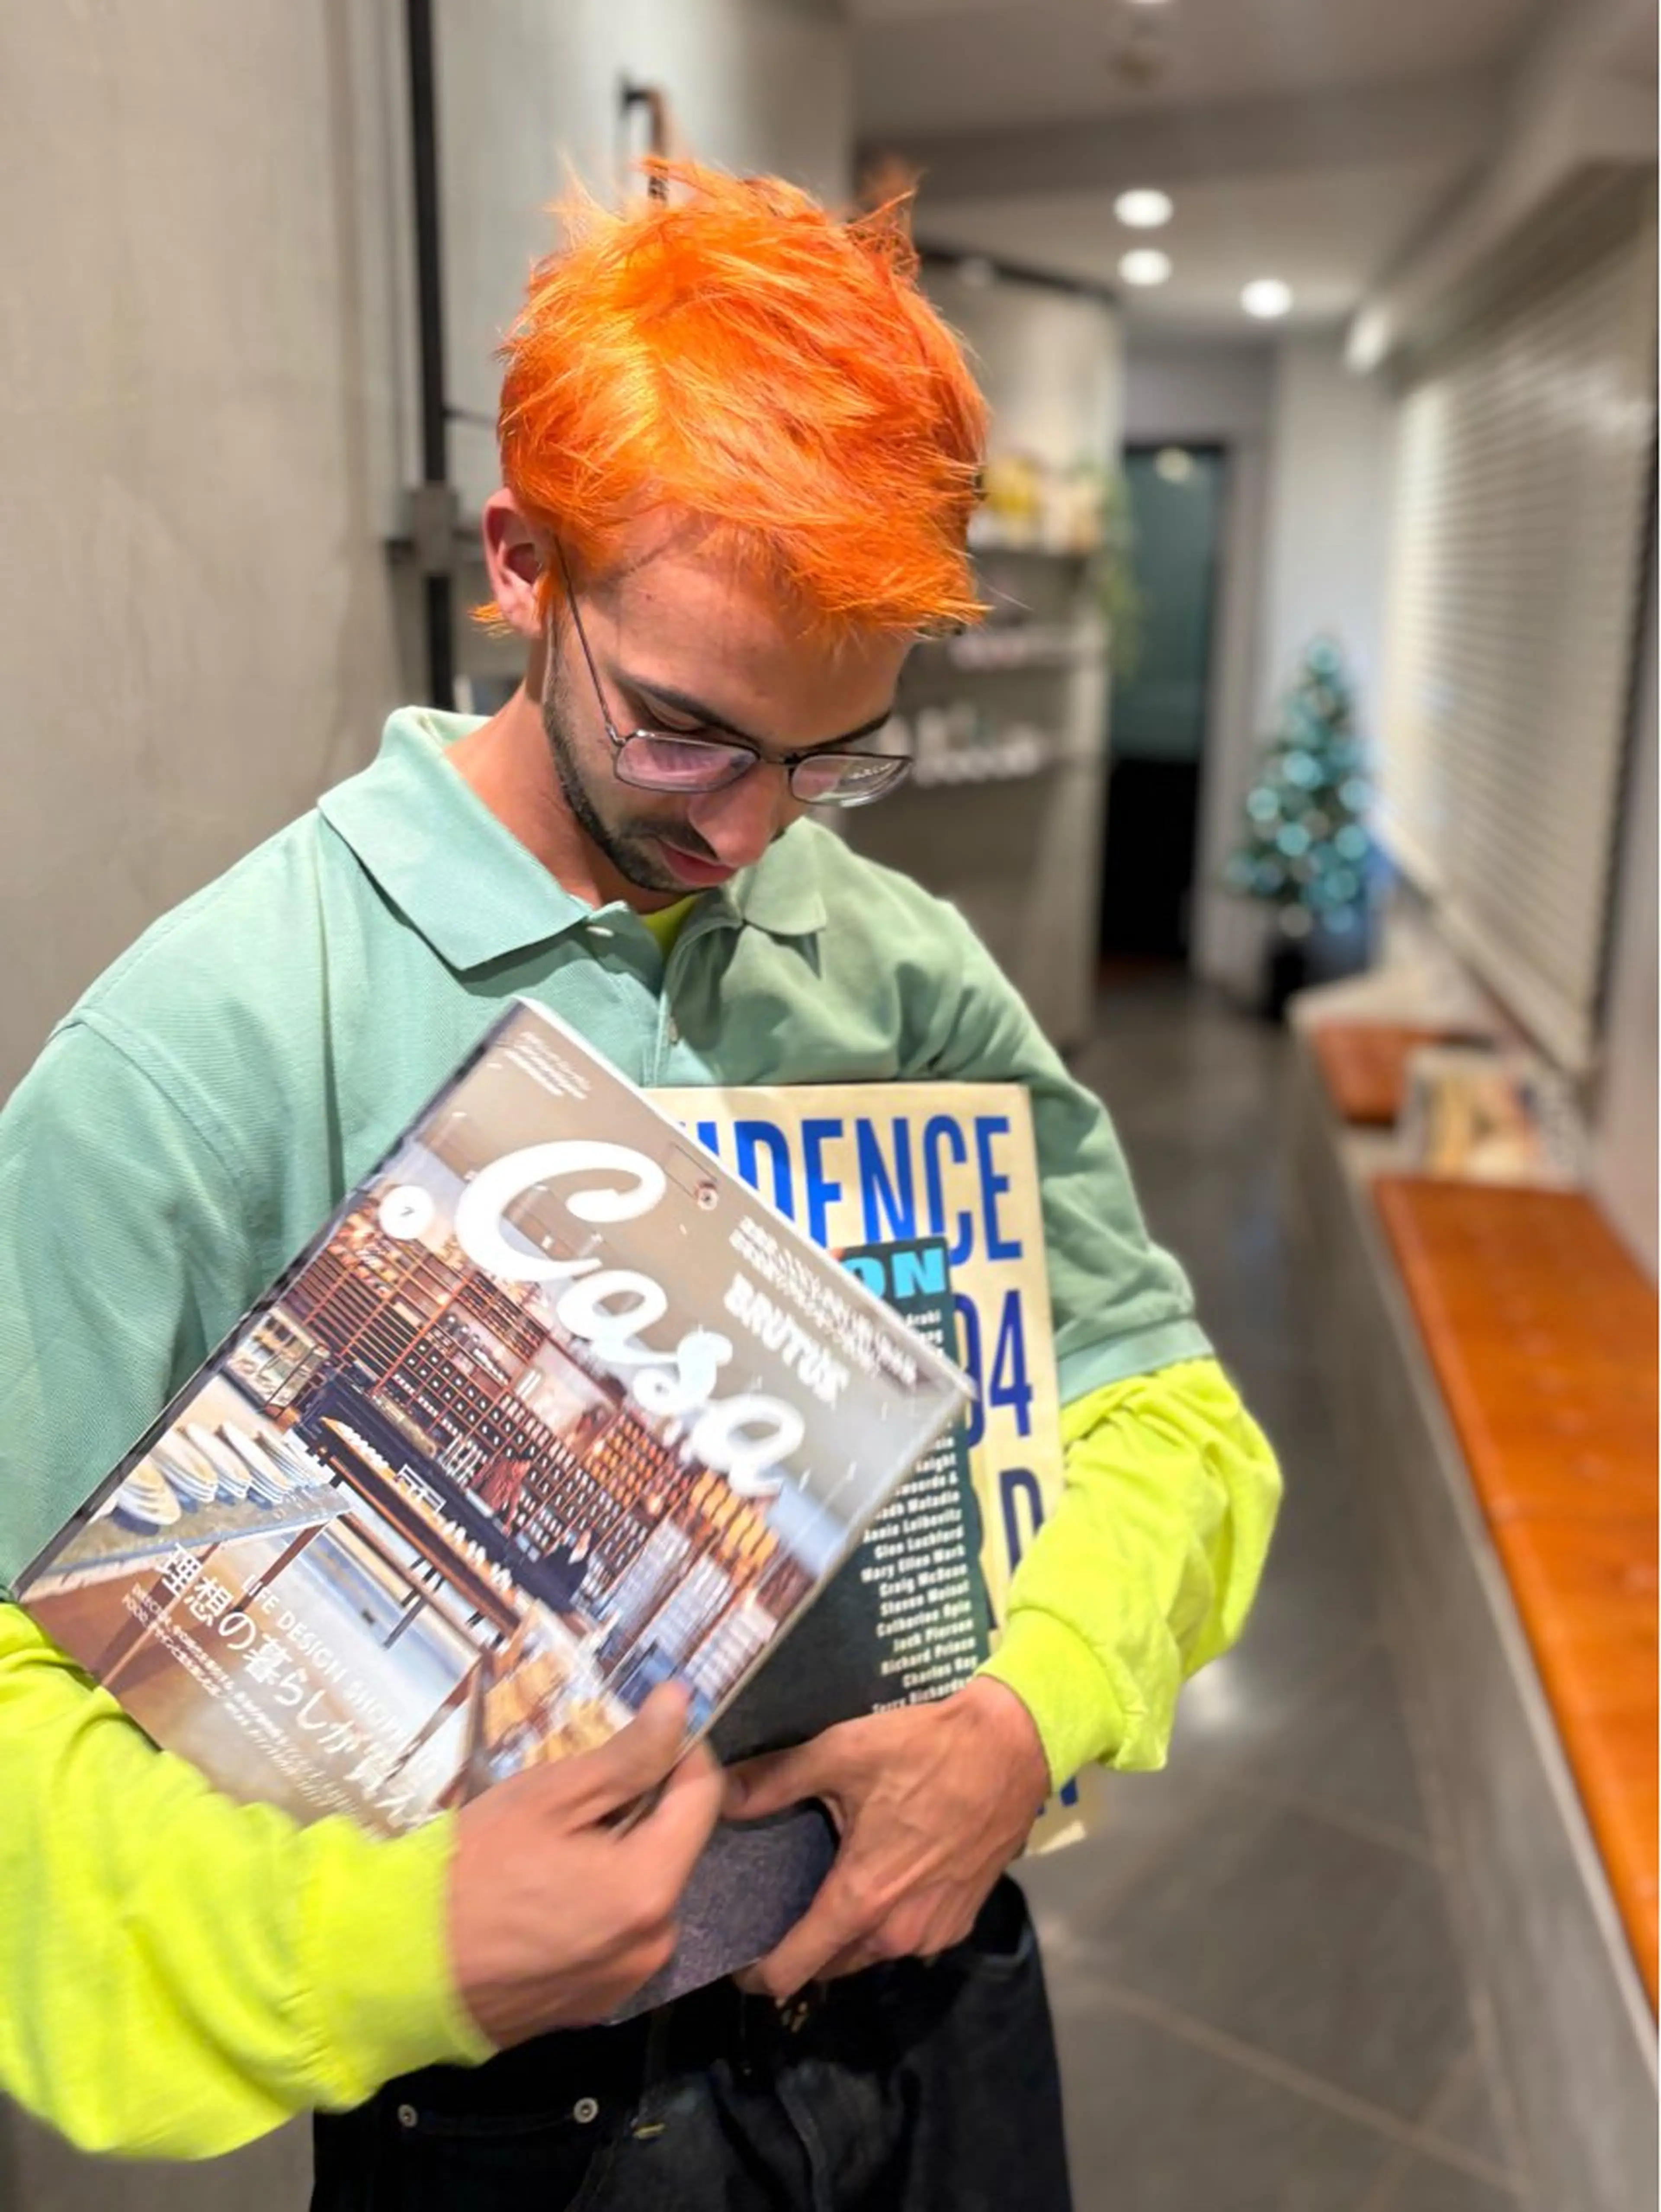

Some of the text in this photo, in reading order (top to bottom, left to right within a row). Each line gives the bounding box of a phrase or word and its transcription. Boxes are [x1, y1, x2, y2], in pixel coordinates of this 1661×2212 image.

[696, 1114, 1024, 1268] DENCE
[454, 1140, 804, 1496] Casa
[724, 1271, 850, 1404] BRUTUS
[860, 1564, 895, 1584] Mary
[932, 1543, 966, 1564] Mark
[874, 1542, 904, 1560] Glen
[241, 1574, 279, 1615] LIFE
[879, 1577, 916, 1598] Craig
[880, 1594, 925, 1617] Steven
[881, 1648, 932, 1676] Richard
[903, 1655, 979, 1689] Charles Ray
